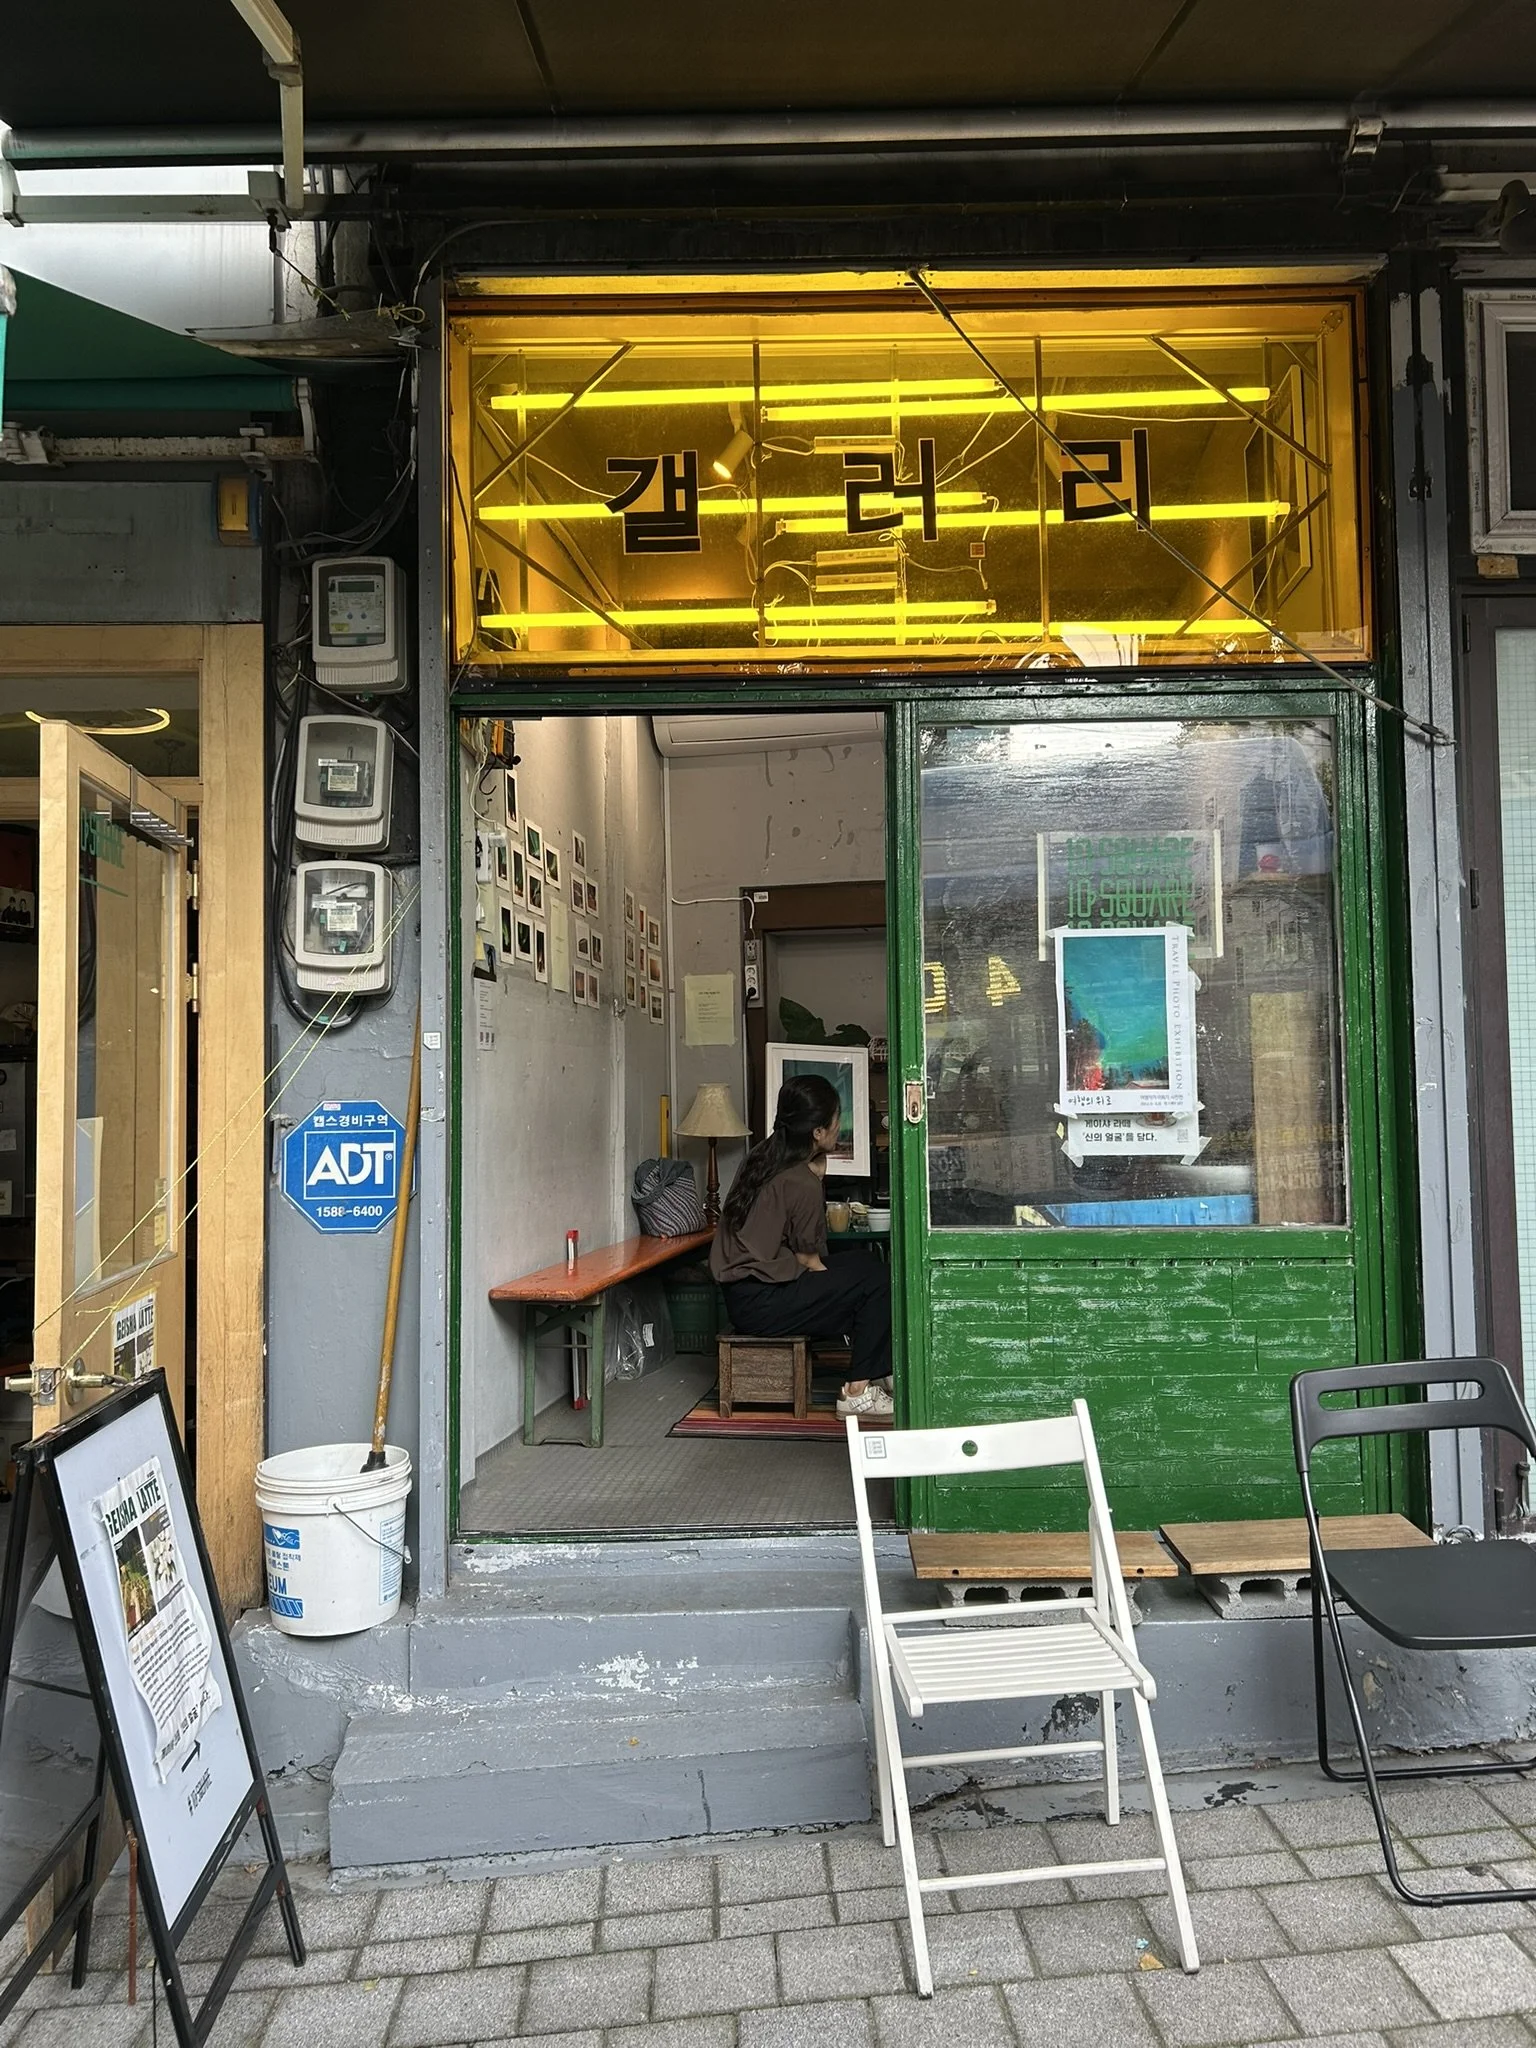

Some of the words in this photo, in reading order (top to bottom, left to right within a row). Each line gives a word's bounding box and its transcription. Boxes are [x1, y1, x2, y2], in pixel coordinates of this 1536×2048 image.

[604, 427, 1153, 555] 갤러리
[1099, 878, 1194, 918] SQUARE
[1171, 935, 1181, 976] TRAVEL
[1172, 980, 1181, 1019] PHOTO
[1173, 1023, 1184, 1090] EXHIBITION
[313, 1114, 389, 1128] 캡스경비구역
[1084, 1118, 1112, 1128] 게이샤
[1113, 1118, 1132, 1128] 라떼
[1136, 1132, 1158, 1143] 담다.
[315, 1204, 383, 1218] 1588-6400
[136, 1478, 161, 1514] LATTE
